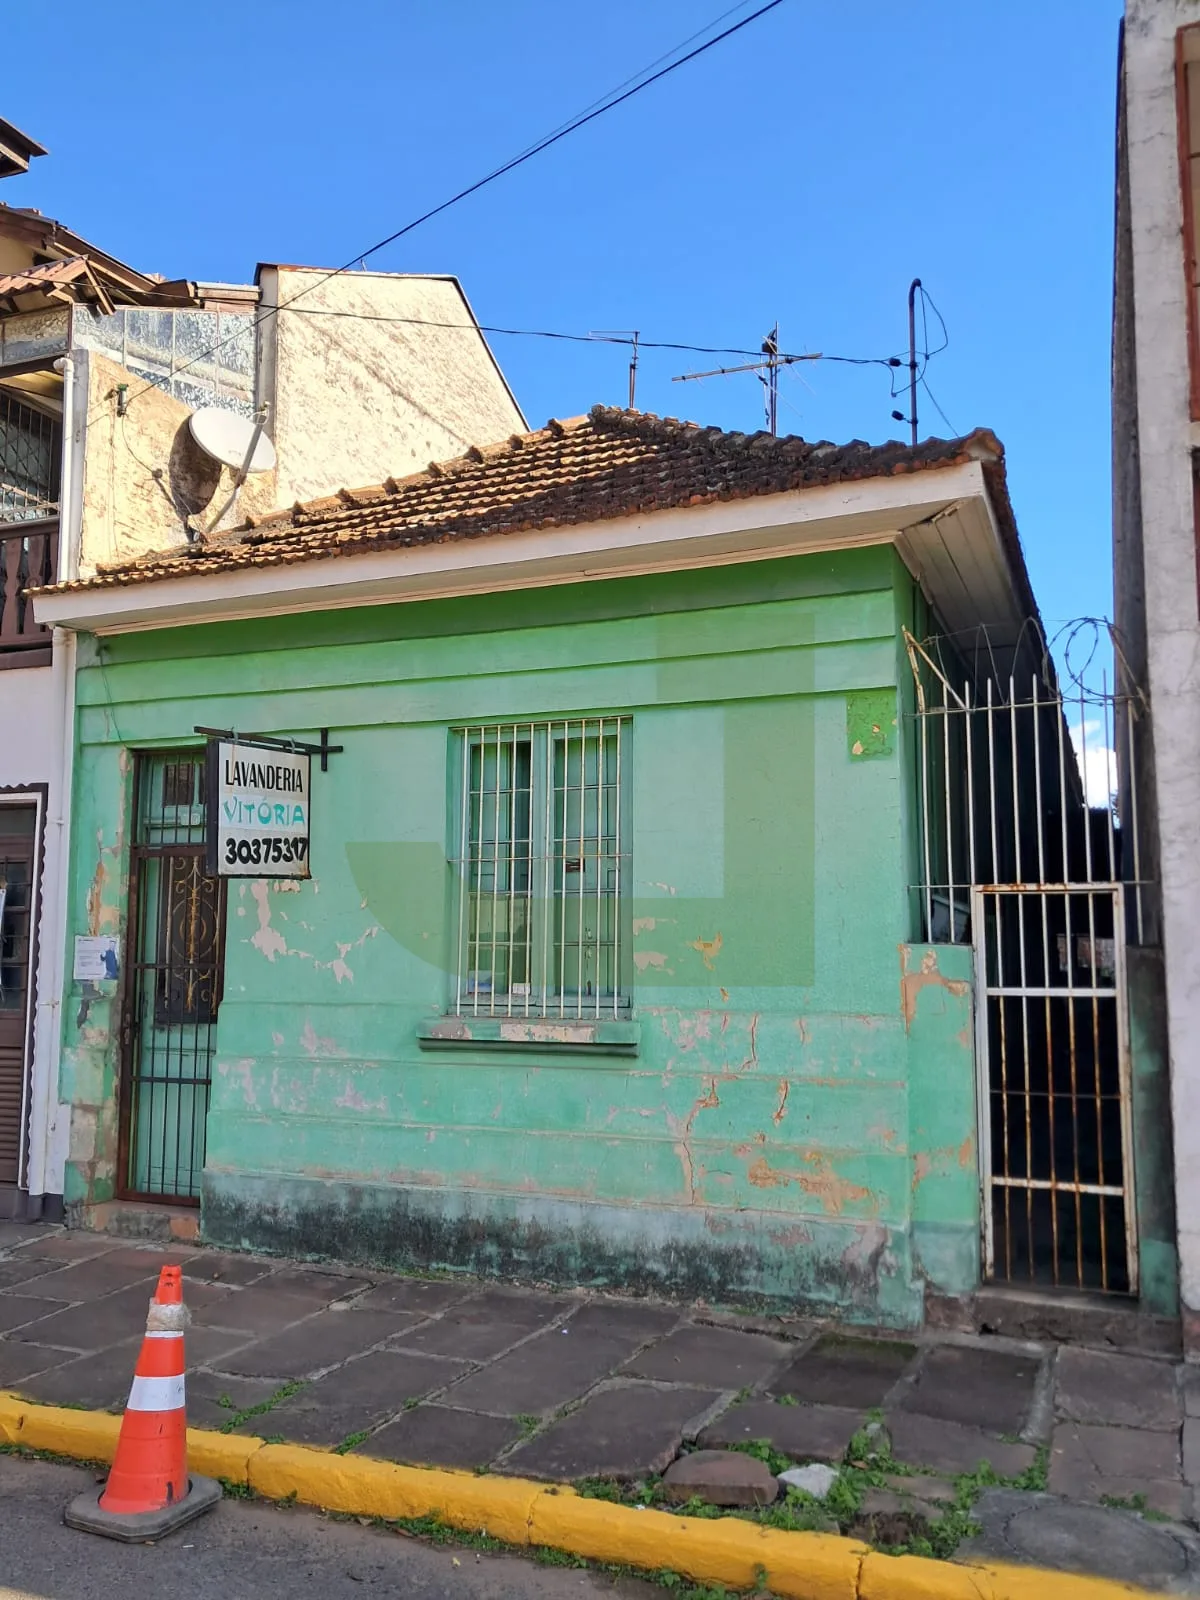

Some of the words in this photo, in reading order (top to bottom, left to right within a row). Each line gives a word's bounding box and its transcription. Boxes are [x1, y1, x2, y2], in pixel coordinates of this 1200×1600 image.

[225, 759, 303, 793] LAVANDERIA
[223, 796, 305, 826] VITÓRIA
[225, 837, 308, 865] 30375317
